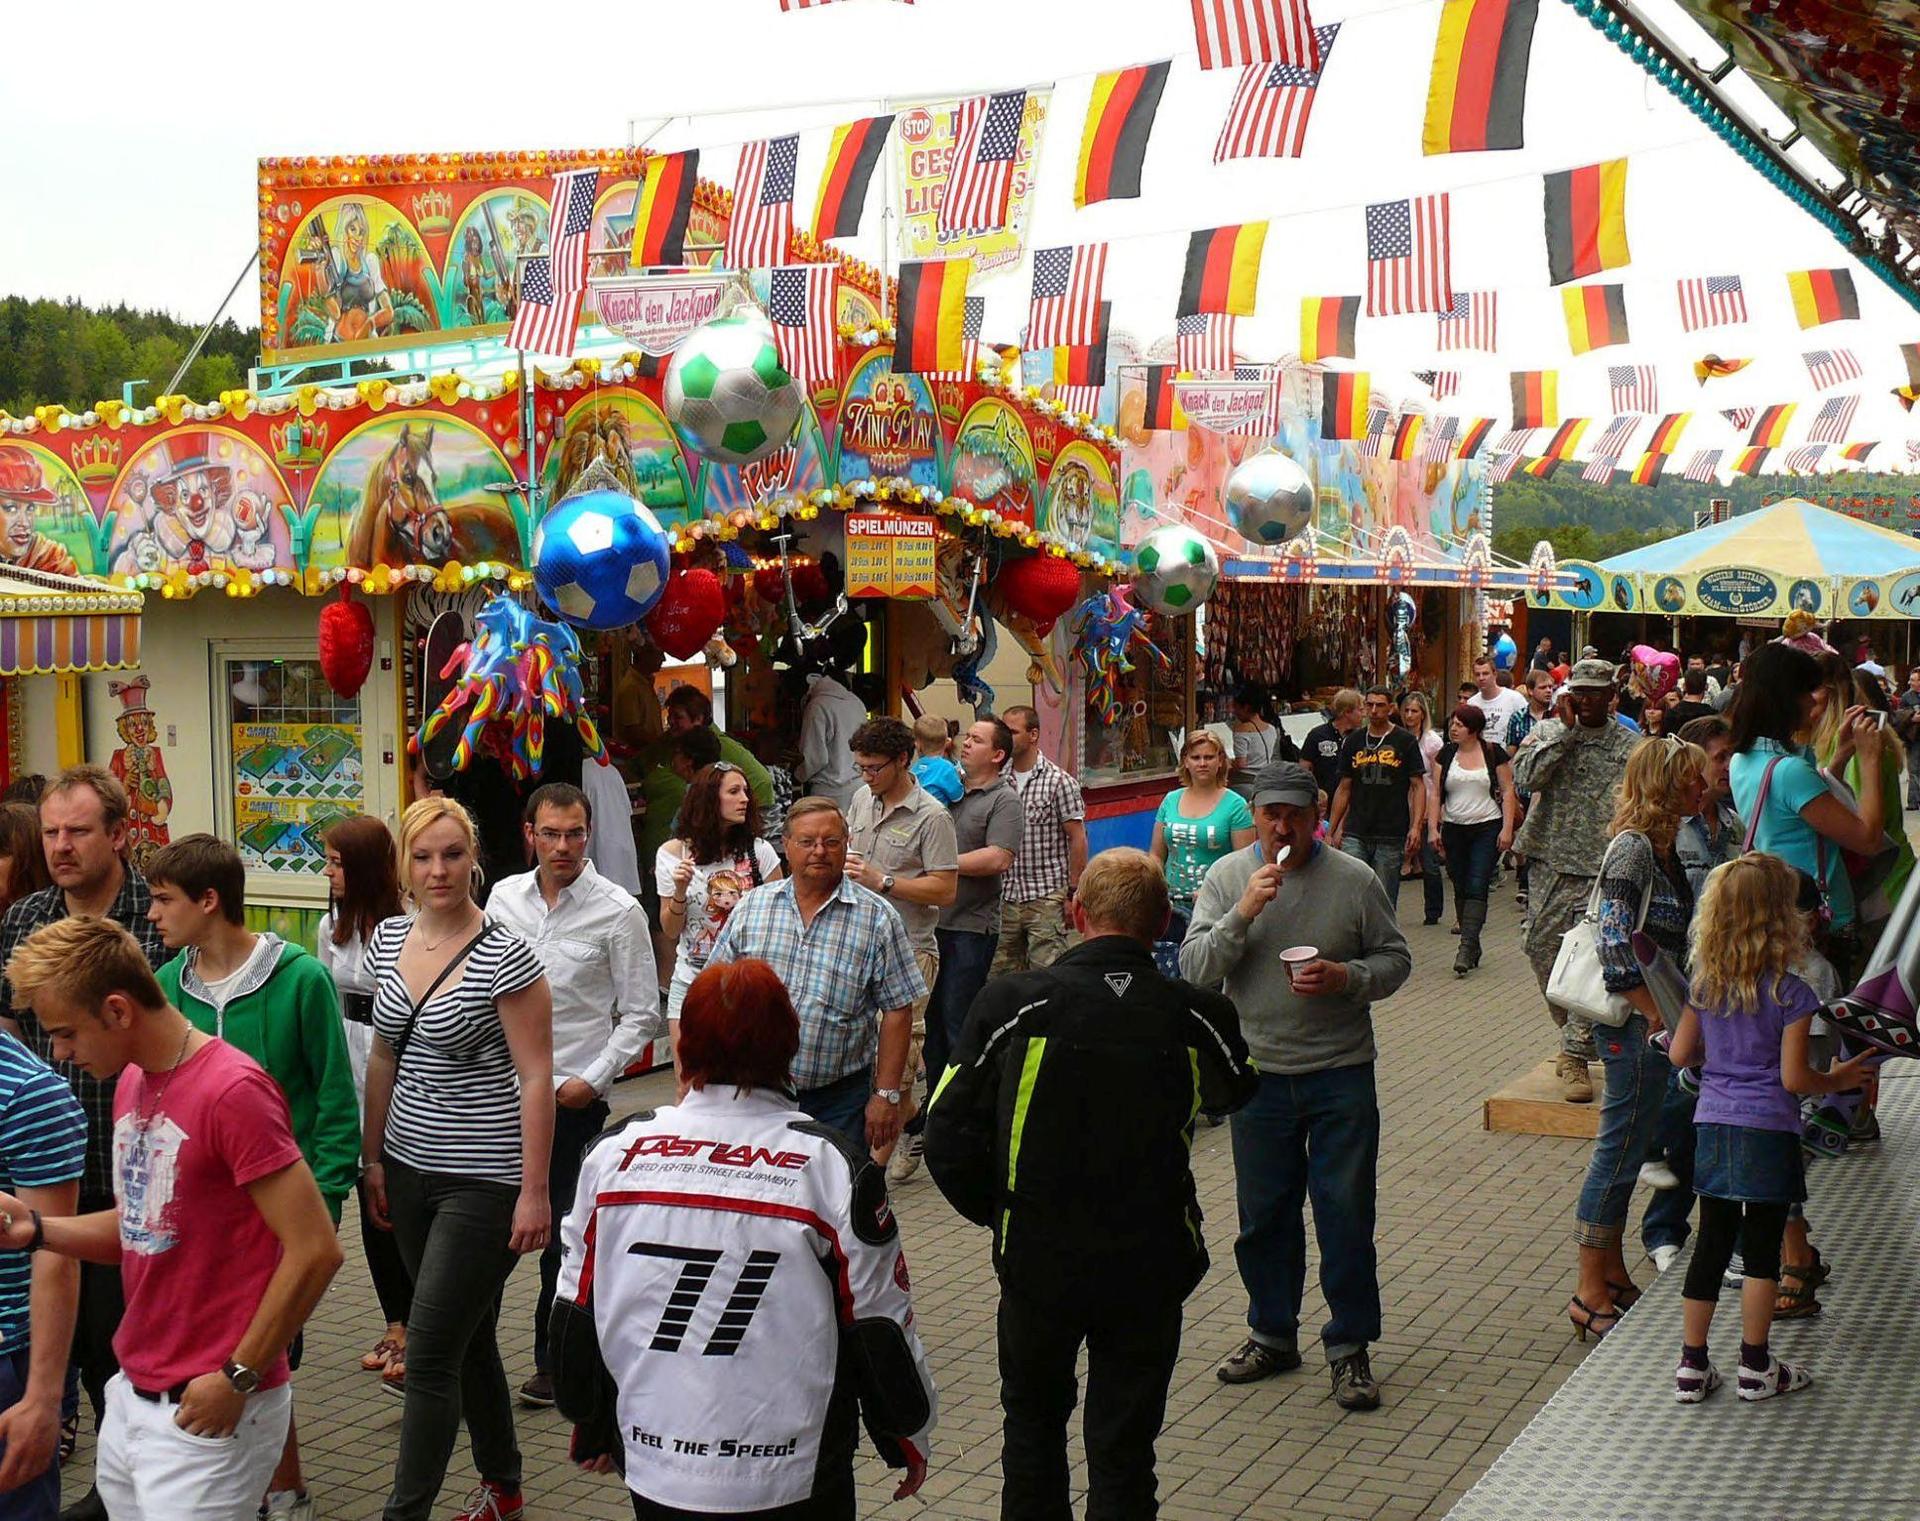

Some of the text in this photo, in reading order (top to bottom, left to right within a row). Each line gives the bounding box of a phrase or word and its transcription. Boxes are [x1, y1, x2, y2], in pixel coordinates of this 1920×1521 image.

[904, 118, 930, 135] STOP
[601, 287, 721, 327] Knack den Jackpot
[1180, 389, 1264, 414] Knack den Jackpot
[849, 517, 933, 535] SPIELMÜNZEN
[629, 1162, 798, 1188] SPEED FIGHTER STREET EQUIPMENT
[632, 1425, 797, 1458] FEEL THE SPEED!
